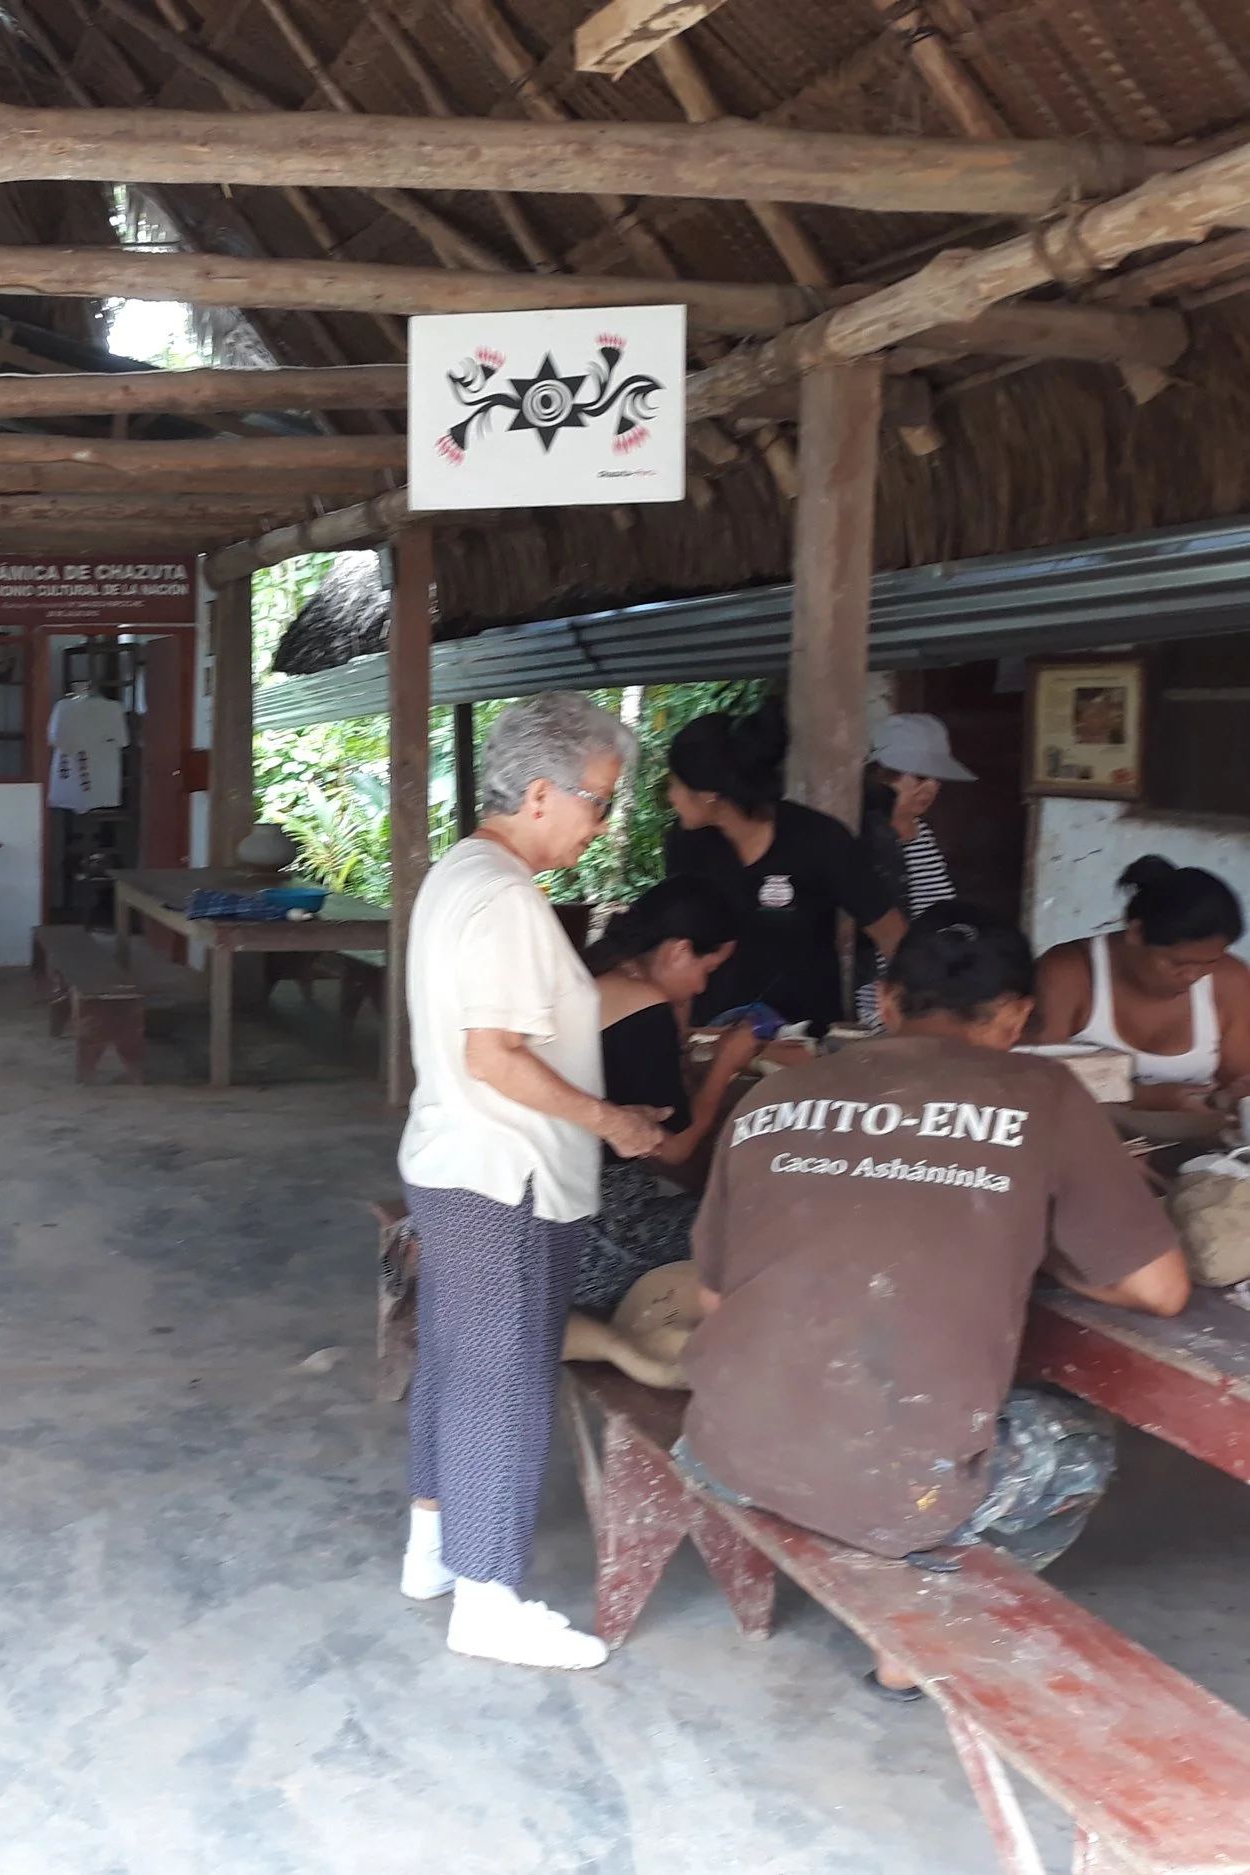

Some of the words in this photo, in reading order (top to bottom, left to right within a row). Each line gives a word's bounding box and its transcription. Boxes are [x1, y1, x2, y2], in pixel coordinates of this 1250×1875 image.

[63, 564, 92, 581] DE
[94, 564, 188, 581] CHAZUTA
[36, 584, 99, 597] CULTURAL
[101, 583, 122, 596] DE
[123, 583, 137, 596] LA
[729, 1099, 1030, 1148] KEMITO-ENE
[770, 1152, 849, 1176] Cacao
[850, 1156, 1012, 1193] Asháninka
